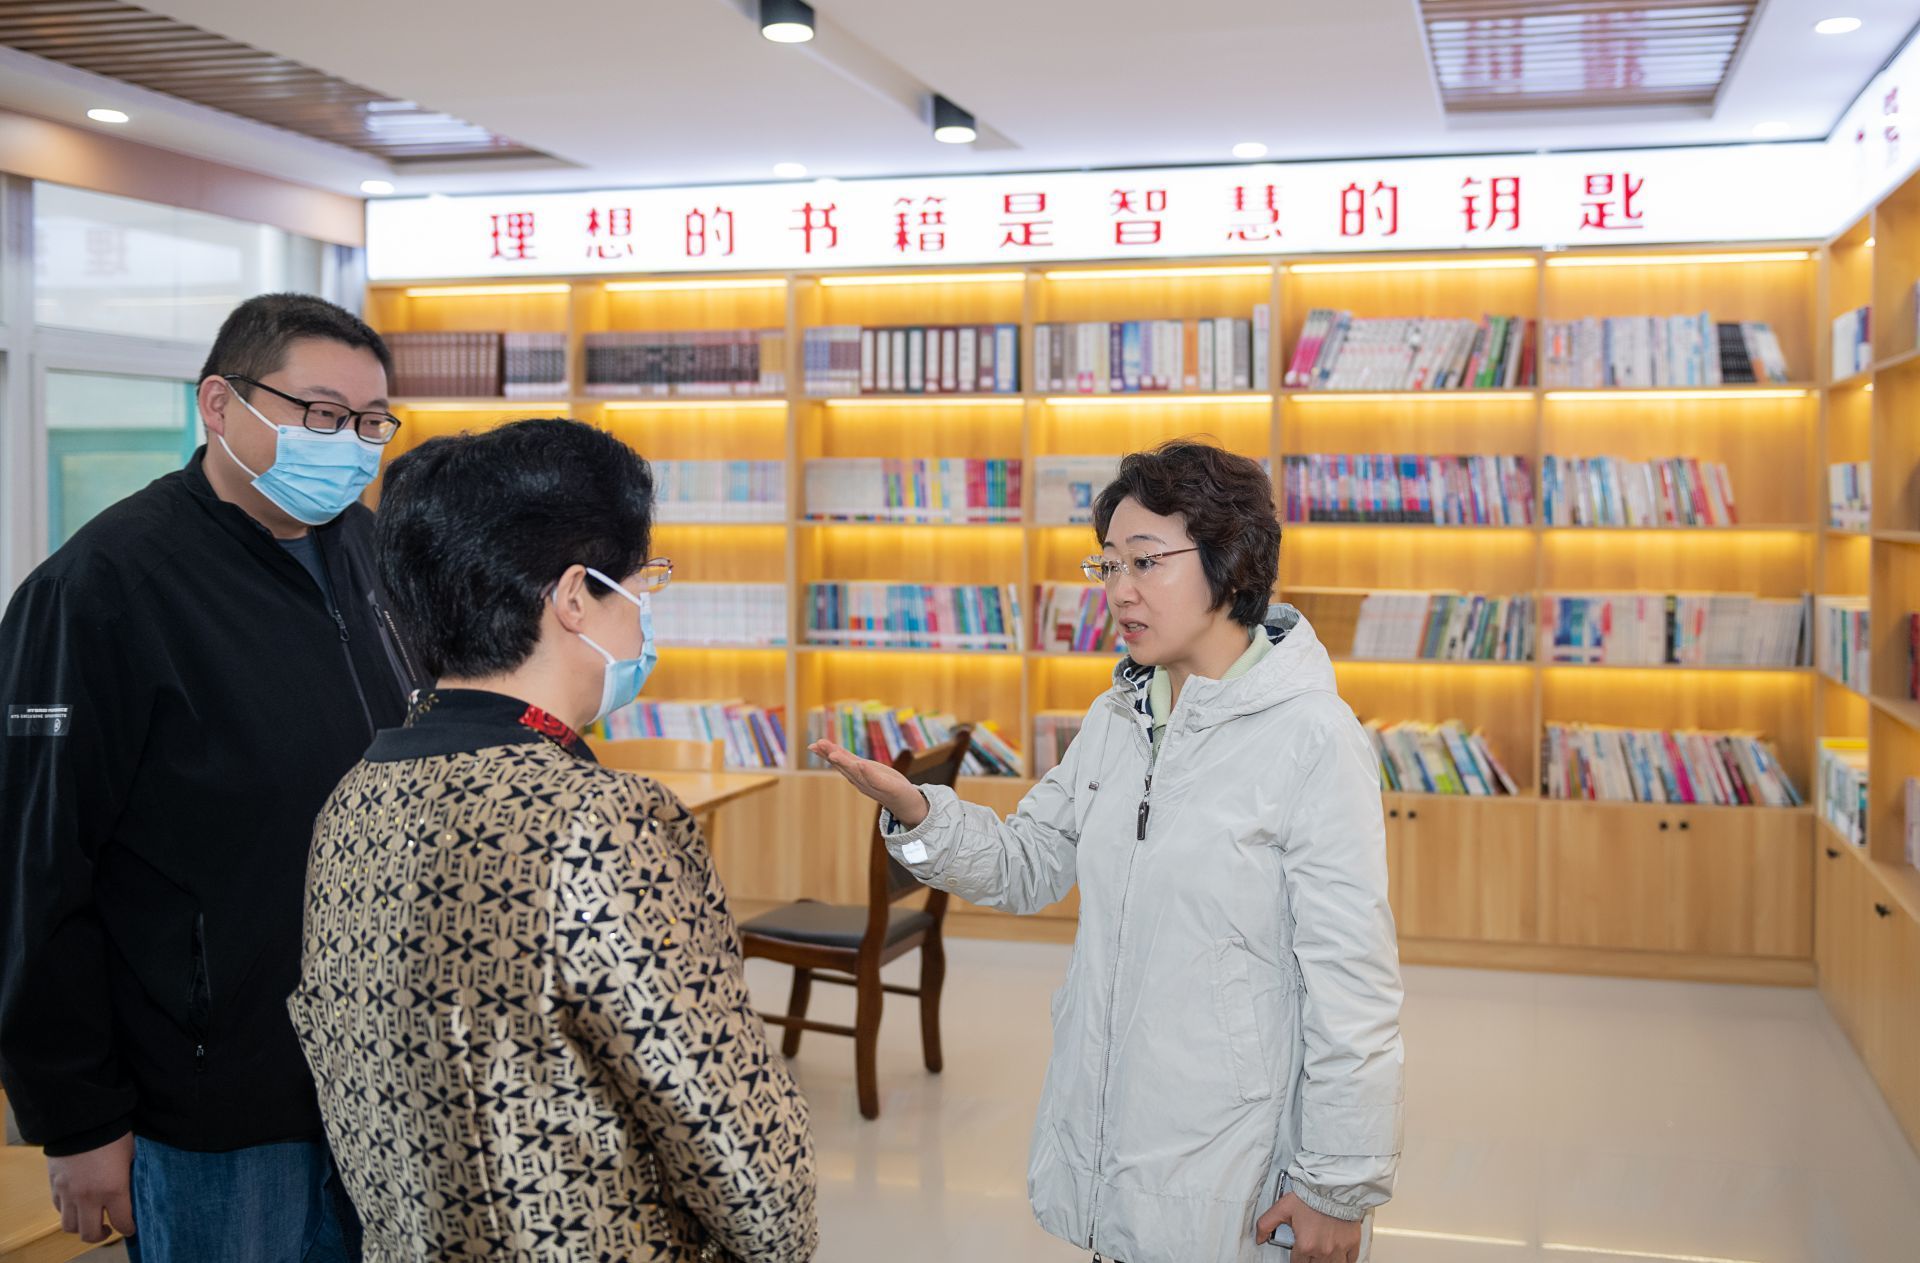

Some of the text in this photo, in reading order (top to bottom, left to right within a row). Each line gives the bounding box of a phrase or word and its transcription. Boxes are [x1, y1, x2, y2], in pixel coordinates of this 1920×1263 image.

[490, 172, 1645, 260] 理想的书籍是智慧的钥匙
